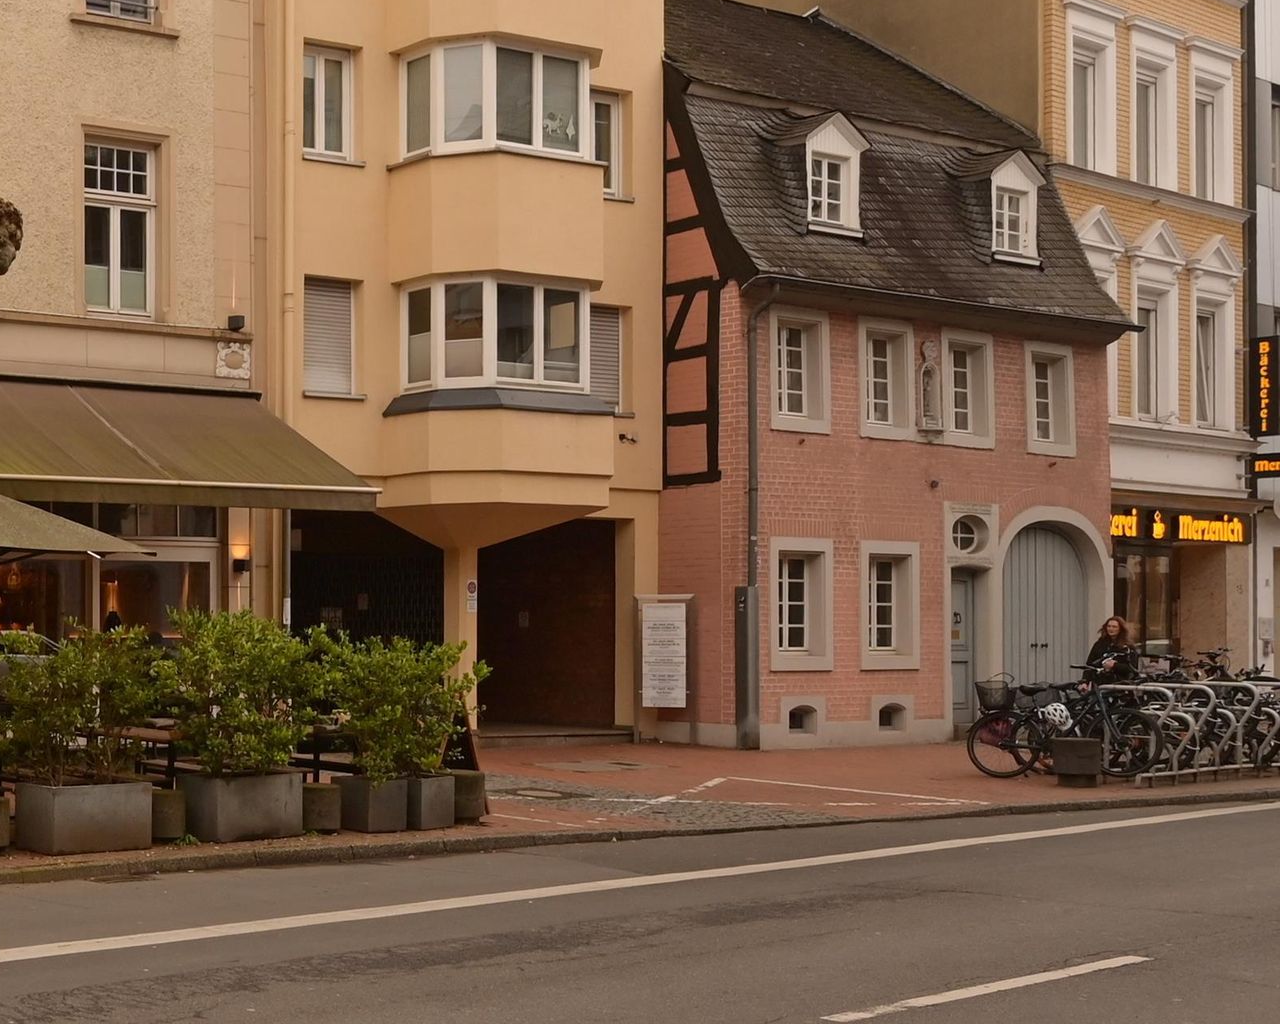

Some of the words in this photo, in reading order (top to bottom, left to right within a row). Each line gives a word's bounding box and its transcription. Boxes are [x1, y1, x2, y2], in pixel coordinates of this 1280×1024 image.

[1258, 341, 1271, 432] Bäckerei
[1110, 507, 1138, 537] erei
[1178, 514, 1244, 543] Merzenich
